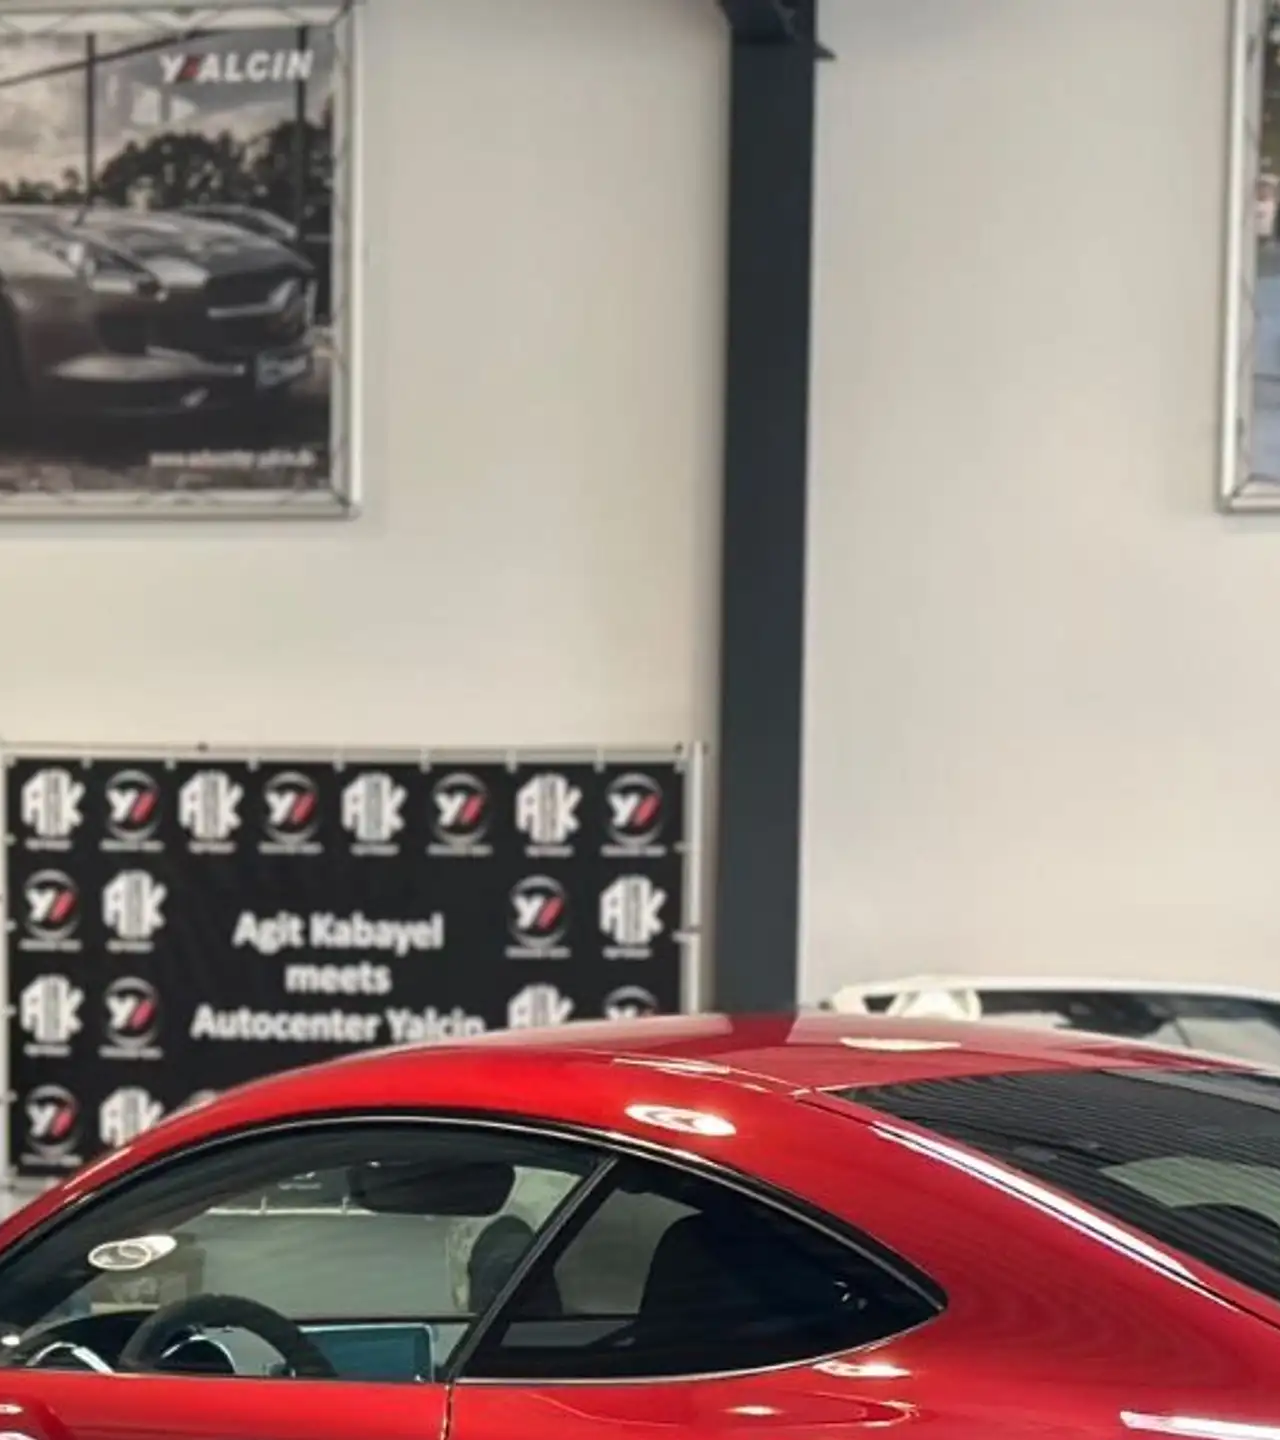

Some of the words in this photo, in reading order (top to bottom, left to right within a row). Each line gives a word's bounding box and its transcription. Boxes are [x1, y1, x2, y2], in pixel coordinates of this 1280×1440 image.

[158, 50, 314, 84] YALCIN
[232, 909, 305, 955] Agit
[308, 909, 445, 957] Kabayel
[284, 960, 393, 994] meets
[190, 1002, 382, 1043] Autocenter
[385, 1005, 488, 1042] Yalcin
